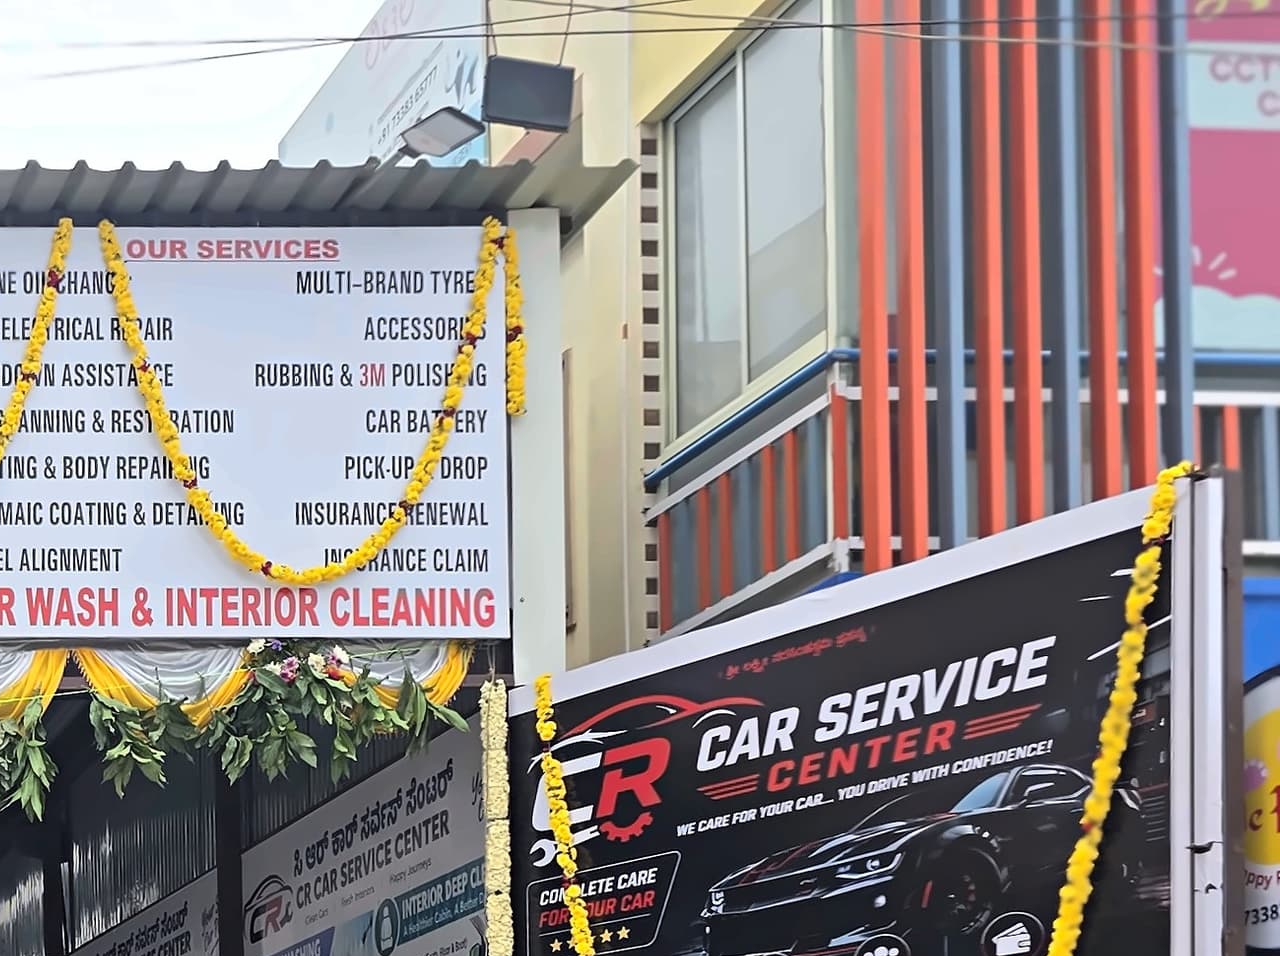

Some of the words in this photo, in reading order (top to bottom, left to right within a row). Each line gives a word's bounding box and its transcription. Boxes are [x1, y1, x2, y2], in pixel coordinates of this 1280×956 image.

[126, 240, 185, 259] OUR
[198, 239, 340, 259] SERVICES
[255, 363, 333, 387] RUBBING
[359, 364, 385, 386] 3M
[366, 410, 400, 433] CAR
[63, 456, 110, 479] BODY
[345, 456, 414, 479] PICK-UP
[441, 456, 487, 479] DROP
[49, 502, 130, 526] COATING
[405, 502, 488, 526] RENEWAL
[20, 548, 122, 572] ALIGNMENT
[434, 549, 488, 572] CLAIM
[26, 588, 119, 626] WASH
[132, 587, 153, 626] &
[165, 588, 319, 627] INTERIOR
[330, 587, 495, 627] CLEANING
[696, 706, 799, 772] CAR
[815, 636, 1057, 743] SERVICE
[767, 719, 956, 793] CENTER
[677, 822, 696, 837] WE
[698, 815, 731, 834] CARE
[731, 808, 757, 828] FOR
[759, 801, 794, 821] YOUR
[838, 786, 865, 801] YOU
[867, 775, 910, 796] DRIVE
[911, 765, 950, 785] WITH
[952, 739, 1054, 776] CONFIDENCE!
[296, 885, 312, 909] CR
[313, 870, 338, 900] CAR
[340, 841, 392, 888] SERVICE
[394, 810, 450, 859] CENTER
[617, 868, 658, 889] CARE
[401, 884, 443, 920] INTERIOR
[445, 873, 468, 900] DEEP
[621, 890, 655, 913] CAR
